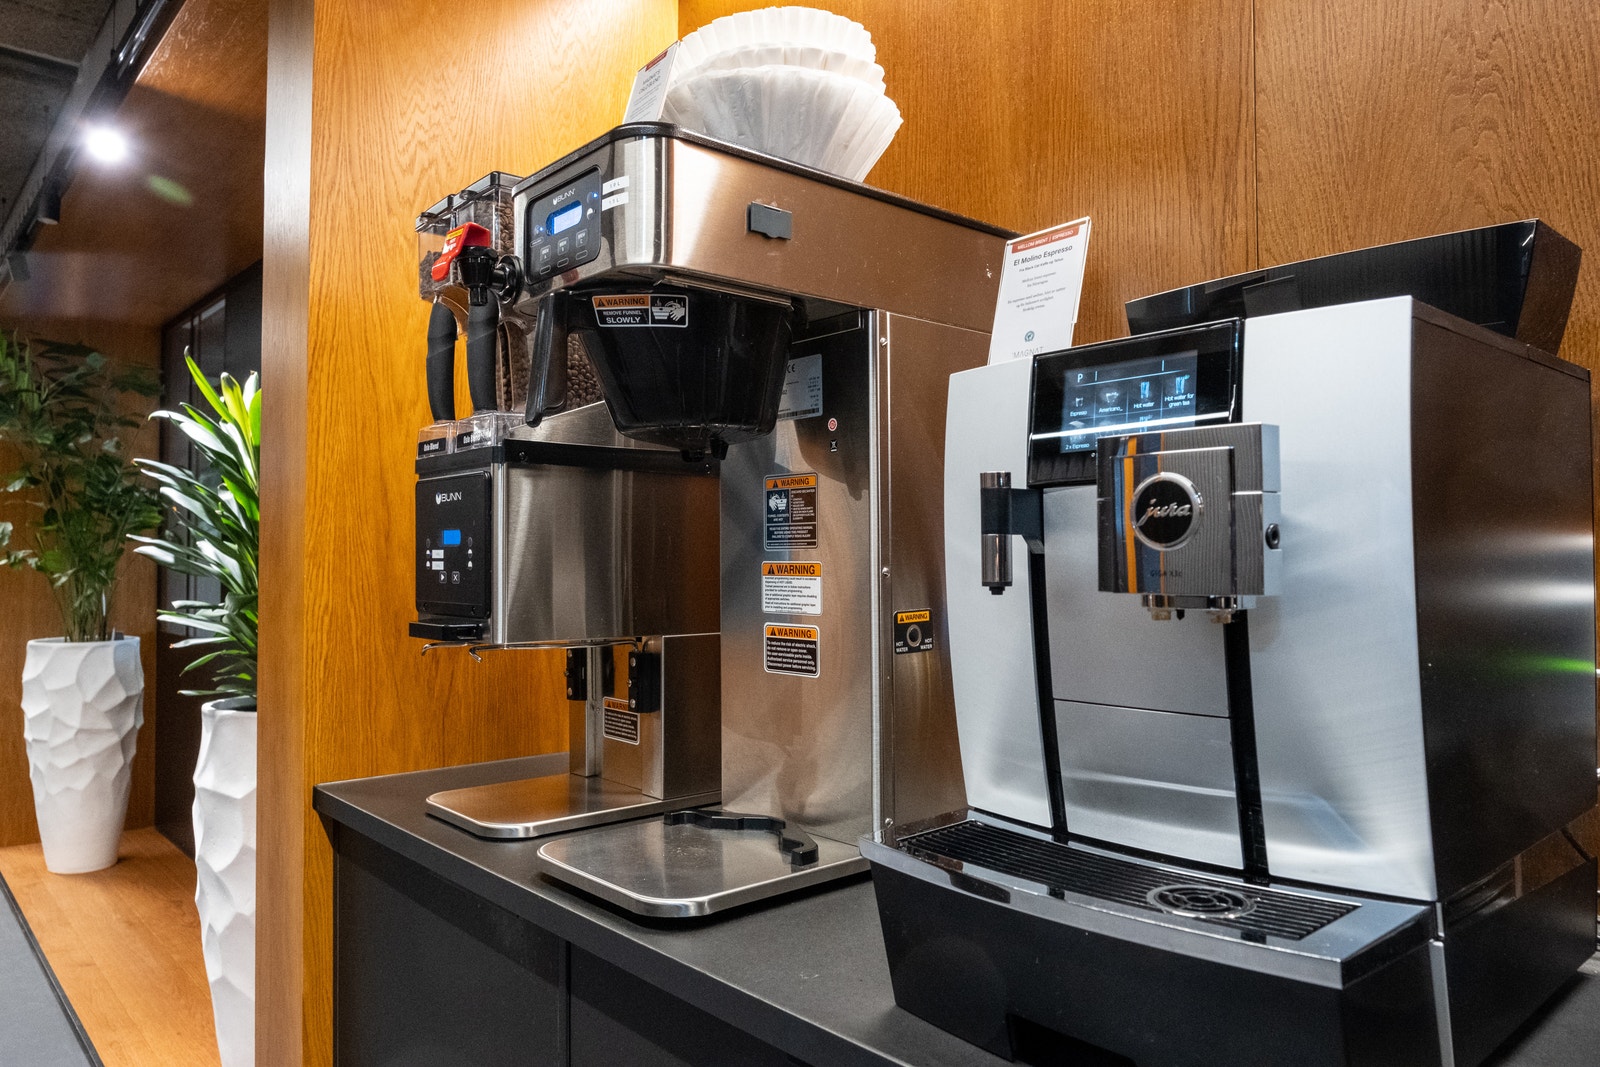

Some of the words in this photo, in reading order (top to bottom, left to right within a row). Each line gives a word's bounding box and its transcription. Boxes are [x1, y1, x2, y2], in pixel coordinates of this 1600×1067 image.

[557, 189, 576, 202] BUNN
[1052, 231, 1073, 240] ESPRESSO
[1021, 254, 1042, 264] Molino
[1043, 245, 1072, 258] Espresso
[1077, 374, 1083, 383] P
[781, 478, 809, 486] WARNING
[442, 492, 462, 502] BUNN
[1137, 499, 1191, 526] jura
[776, 565, 815, 574] WARNING
[778, 628, 811, 638] WARNING
